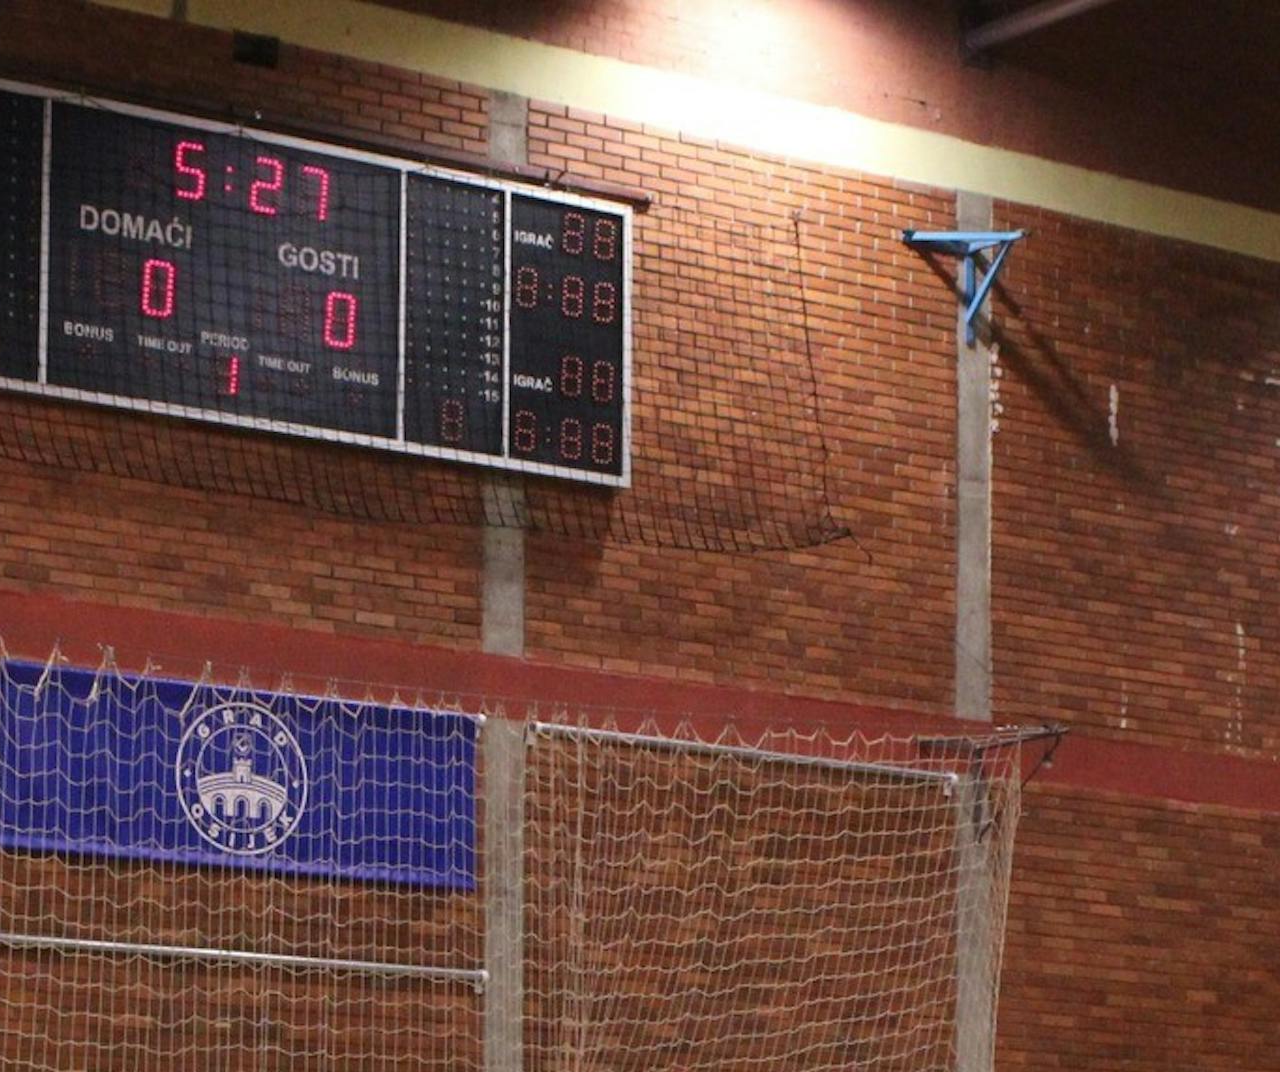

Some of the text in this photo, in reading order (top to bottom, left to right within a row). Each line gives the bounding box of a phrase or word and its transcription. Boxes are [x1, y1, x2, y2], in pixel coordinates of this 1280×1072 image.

[175, 140, 330, 222] 5:27
[79, 204, 193, 249] DOMAĆI
[278, 242, 360, 280] GOSTI
[141, 257, 178, 319] 0
[63, 321, 115, 343] BONUS
[323, 289, 359, 349] 0
[137, 334, 193, 354] TIME OUT
[258, 355, 312, 374] TIME OUT
[227, 354, 240, 397] 1
[331, 364, 380, 388] BONUS
[196, 708, 289, 748] GRAD
[190, 803, 295, 849] OSIJEK
